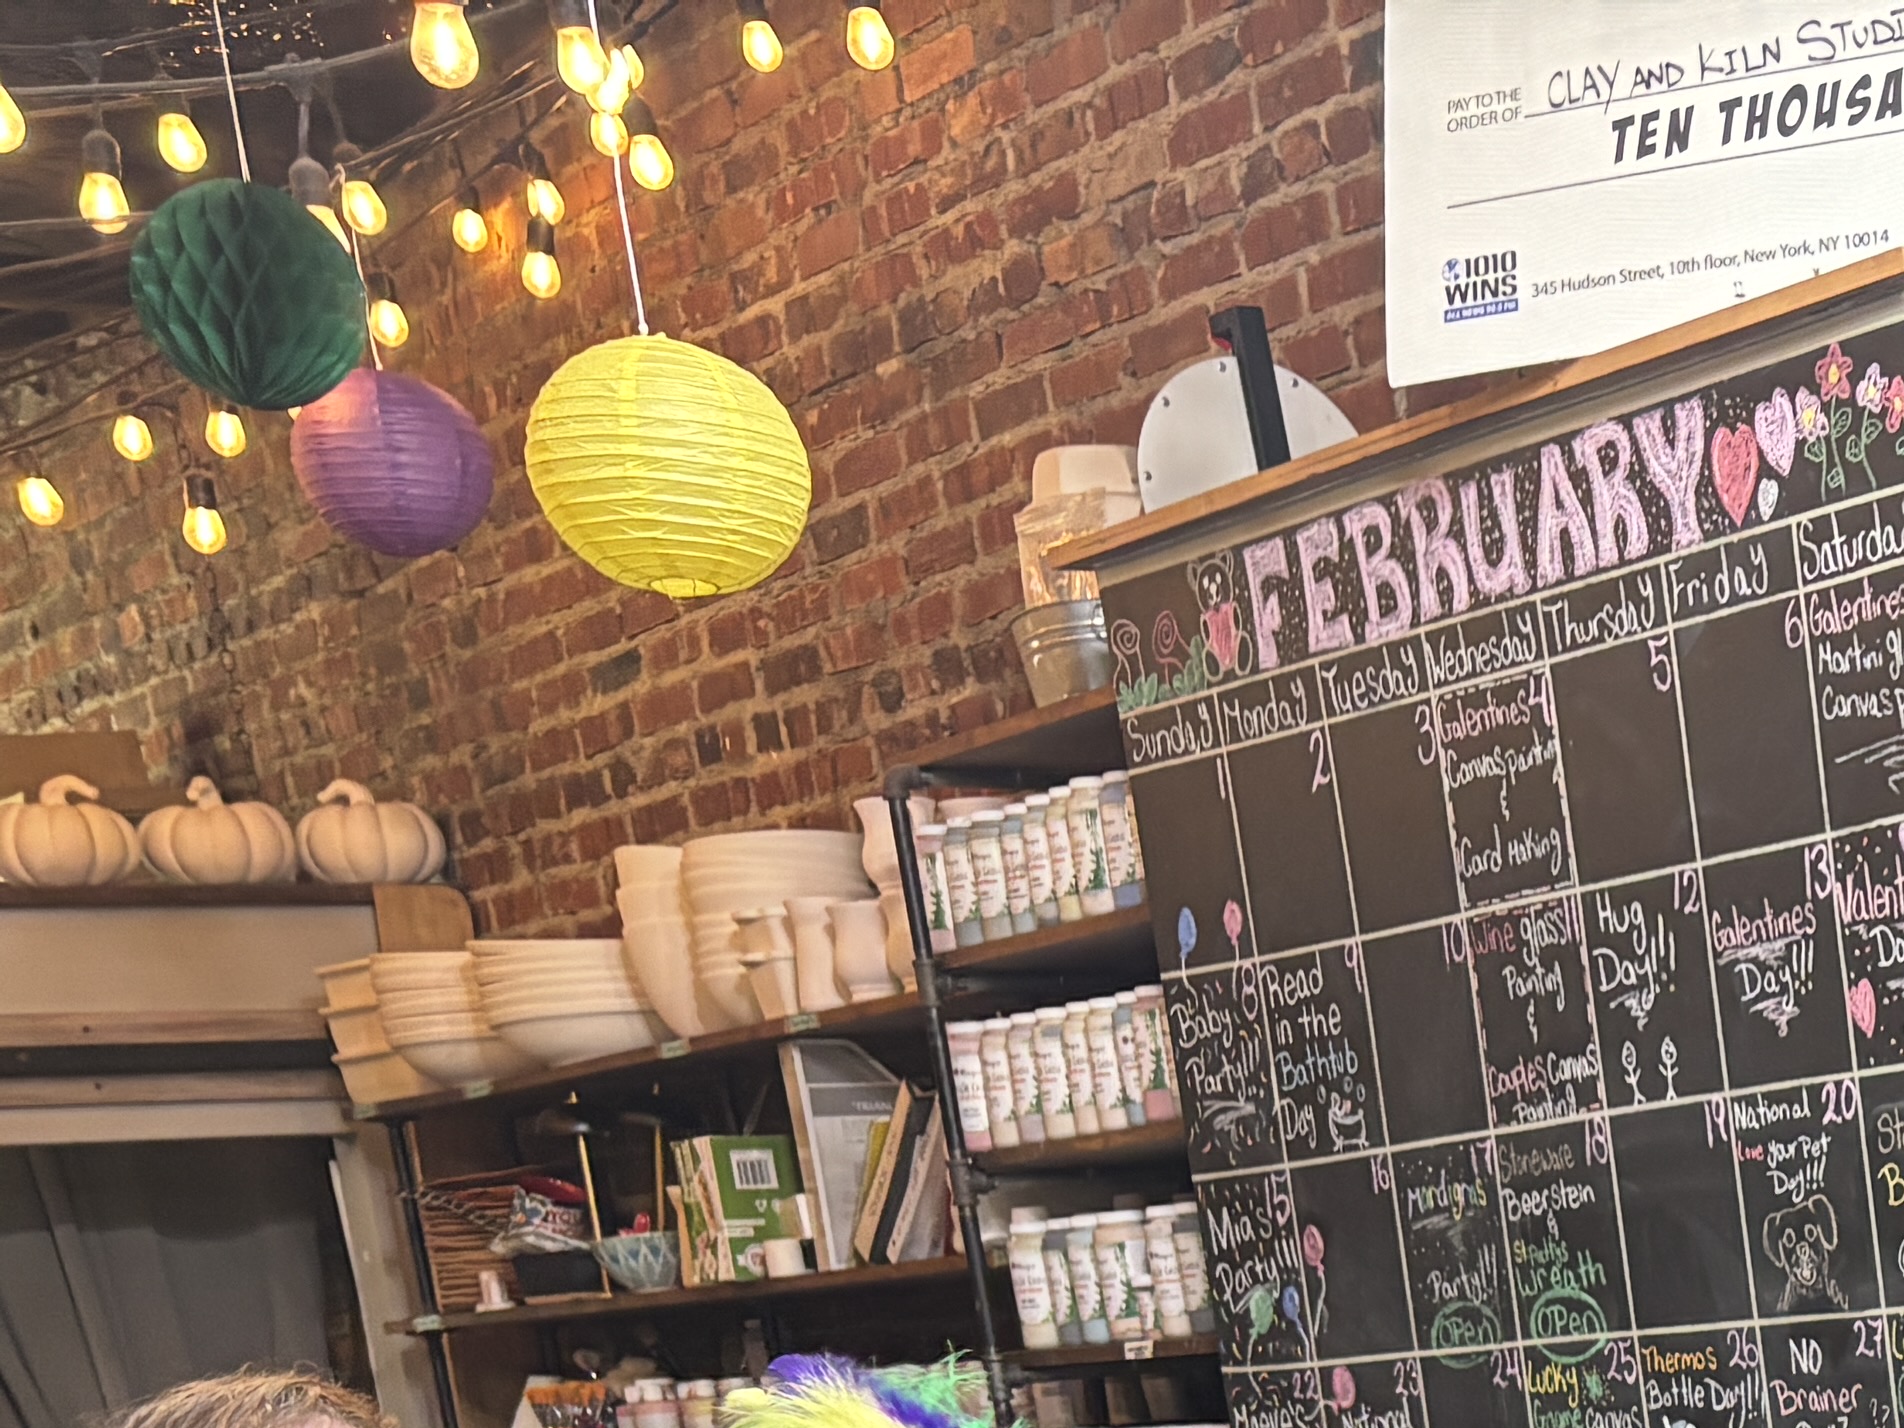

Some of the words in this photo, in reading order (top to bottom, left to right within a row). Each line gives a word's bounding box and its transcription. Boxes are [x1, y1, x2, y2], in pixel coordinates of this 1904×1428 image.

[1447, 94, 1475, 114] PAY
[1475, 91, 1493, 108] TO
[1494, 87, 1522, 104] THE
[1548, 60, 1620, 114] CLAY
[1631, 60, 1685, 98] AND
[1699, 36, 1780, 82] KILN
[1447, 109, 1499, 132] ORDER
[1502, 105, 1522, 124] OF
[1612, 104, 1695, 165] TEN
[1445, 274, 1518, 306] WINS
[1465, 250, 1517, 279] 1010
[1532, 281, 1558, 298] 345
[1561, 270, 1616, 295] Hudson
[1619, 263, 1666, 287] Street,
[1669, 256, 1701, 277] 10th
[1703, 251, 1741, 274] floor,
[1743, 246, 1777, 266] New
[1779, 238, 1815, 260] York,
[1818, 235, 1840, 251] NY
[1843, 229, 1889, 249] 10014
[1243, 400, 1704, 671] FEBRUARY
[1669, 542, 1769, 615] Friday
[1543, 572, 1656, 652] Thursday
[1784, 597, 1804, 648] 6
[1425, 609, 1537, 685] Wednesday
[1648, 635, 1673, 692] 5
[1818, 629, 1883, 674] Martini
[1321, 646, 1420, 716] Tuesday
[1437, 688, 1530, 743] Galentines
[1528, 672, 1551, 727] 4
[1822, 685, 1893, 720] Canvas
[1127, 700, 1213, 763] Sunday
[1223, 677, 1308, 744] Monday
[1415, 704, 1437, 765] 3
[1309, 729, 1332, 794] 2
[1447, 745, 1506, 788] Canvas
[1459, 823, 1503, 878] Card
[1805, 844, 1833, 900] 13
[1673, 870, 1700, 915] 12
[1442, 919, 1466, 970] 10
[1470, 920, 1517, 955] Wine
[1519, 905, 1567, 968] glass
[1595, 890, 1648, 956] Hug
[1712, 897, 1817, 953] Galentines
[1241, 964, 1258, 1021] 8
[1260, 949, 1324, 1009] Read
[1344, 940, 1362, 993] 9
[1170, 993, 1232, 1049] Baby
[1275, 1013, 1294, 1046] in
[1297, 1002, 1342, 1039] the
[1275, 1037, 1359, 1092] Bathtub
[1489, 1055, 1548, 1101] Couples
[1547, 1042, 1600, 1086] Canvas
[1278, 1097, 1317, 1149] Day
[1704, 1092, 1728, 1149] 19
[1734, 1085, 1812, 1132] National
[1820, 1078, 1857, 1126] 20
[1469, 1139, 1494, 1176] 17
[1500, 1141, 1577, 1184] Stoneware
[1584, 1115, 1609, 1167] 18
[1798, 1131, 1832, 1159] Pet
[1263, 1172, 1293, 1228] 15
[1371, 1153, 1390, 1194] 16
[1206, 1206, 1273, 1256] Mia's
[1641, 1346, 1718, 1374] Thermos
[1727, 1328, 1759, 1370] 26
[1788, 1338, 1822, 1376] NO
[1854, 1317, 1884, 1360] 27
[1292, 1369, 1319, 1400] 22
[1393, 1358, 1421, 1396] 23
[1489, 1348, 1523, 1392] 24
[1527, 1360, 1579, 1408] Lucky
[1604, 1340, 1638, 1385] 25
[1646, 1374, 1705, 1411] Bottle
[1770, 1379, 1863, 1417] Brainer
